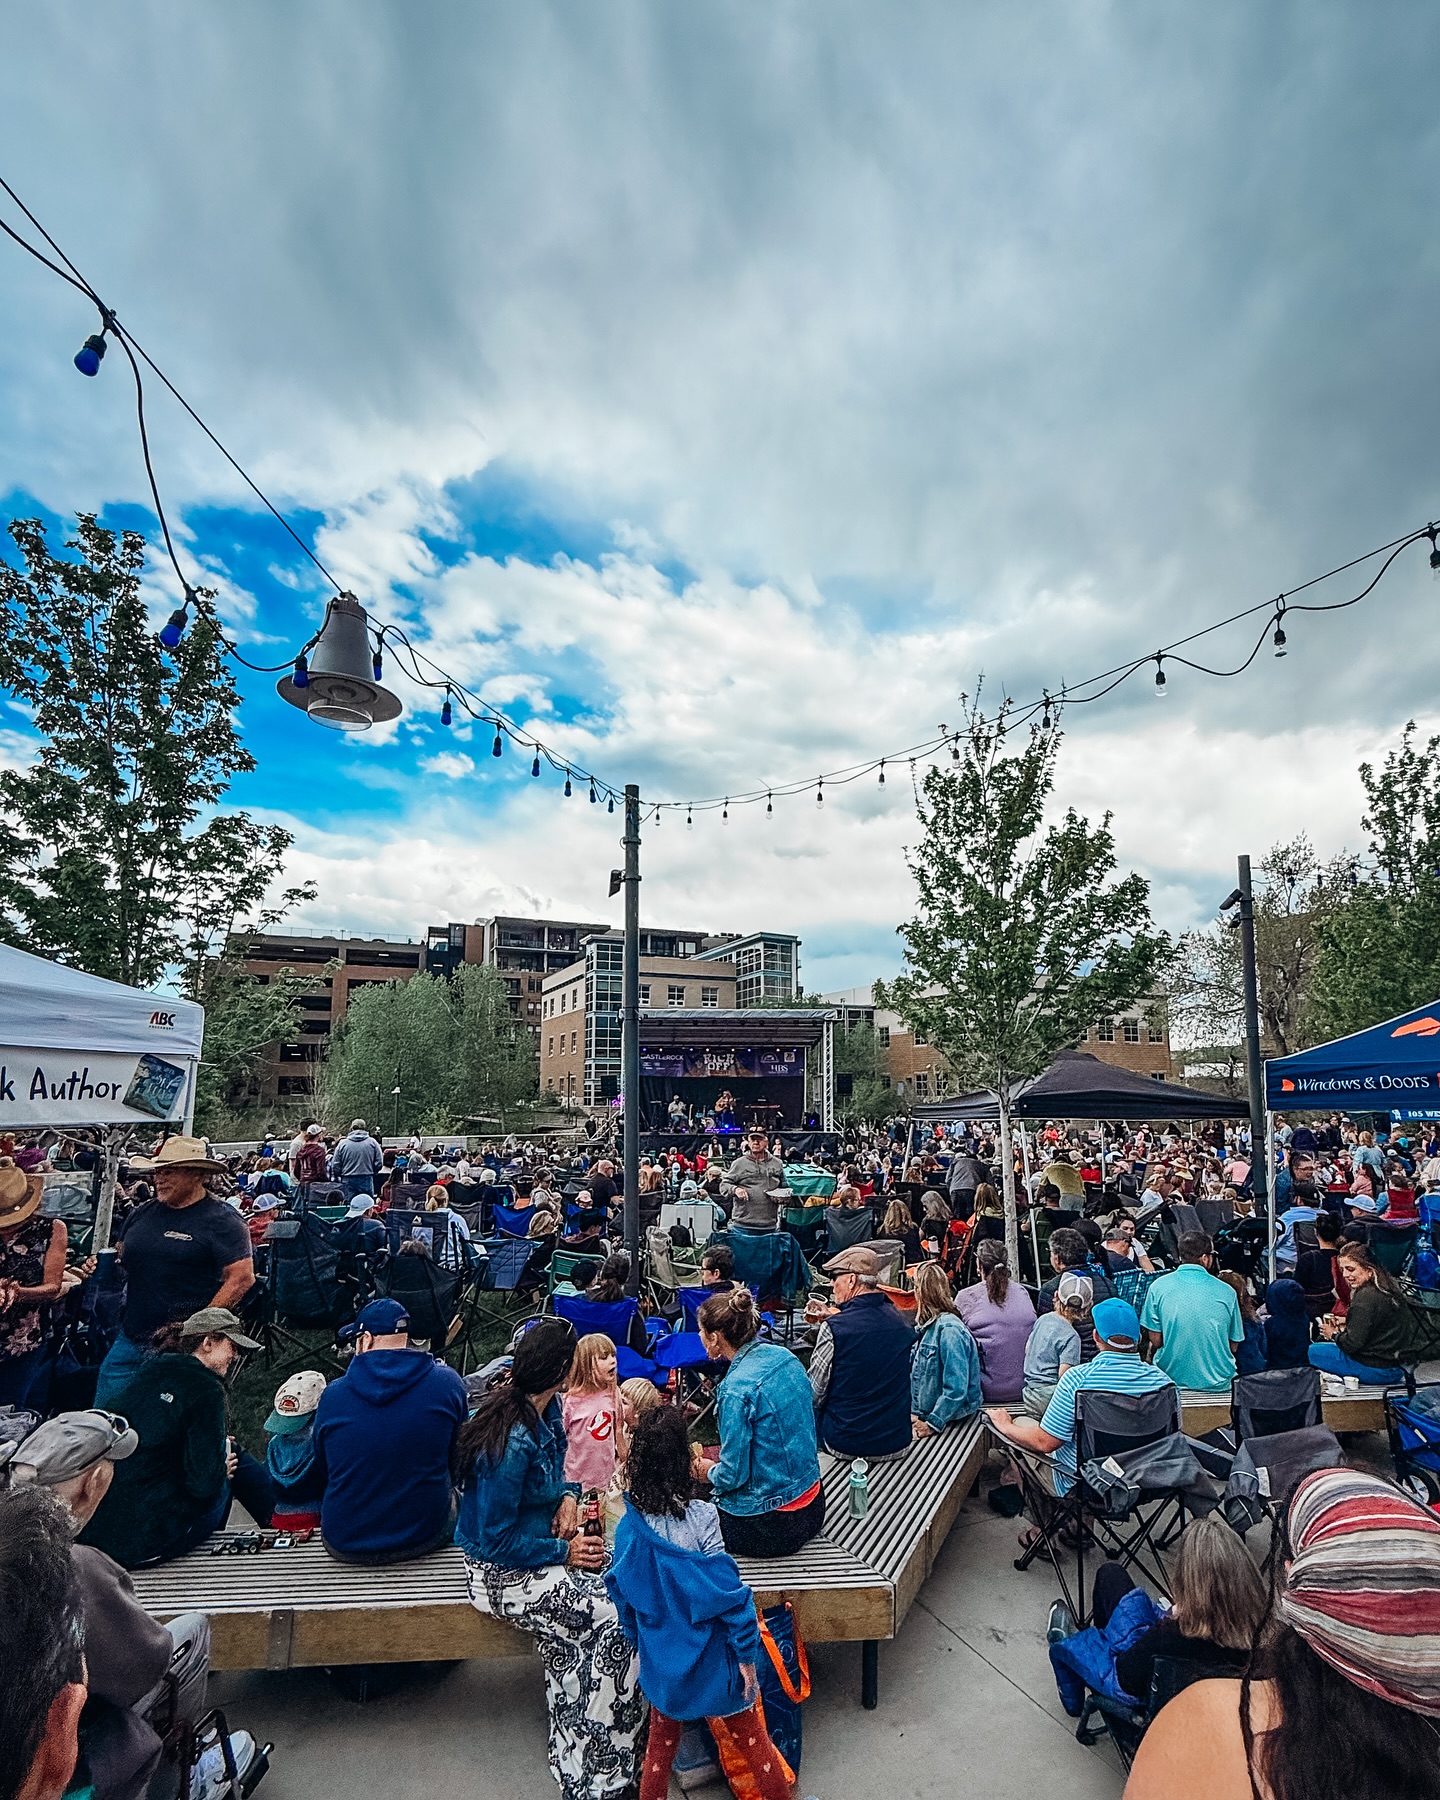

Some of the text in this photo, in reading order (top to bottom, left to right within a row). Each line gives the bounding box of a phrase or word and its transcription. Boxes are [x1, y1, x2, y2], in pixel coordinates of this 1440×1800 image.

[150, 1011, 176, 1026] ABC
[703, 1053, 735, 1064] KICK
[707, 1062, 731, 1071] OFF
[30, 1066, 122, 1101] Author
[1297, 1075, 1430, 1091] Windows & Doors
[1407, 1110, 1440, 1118] 105 WE
